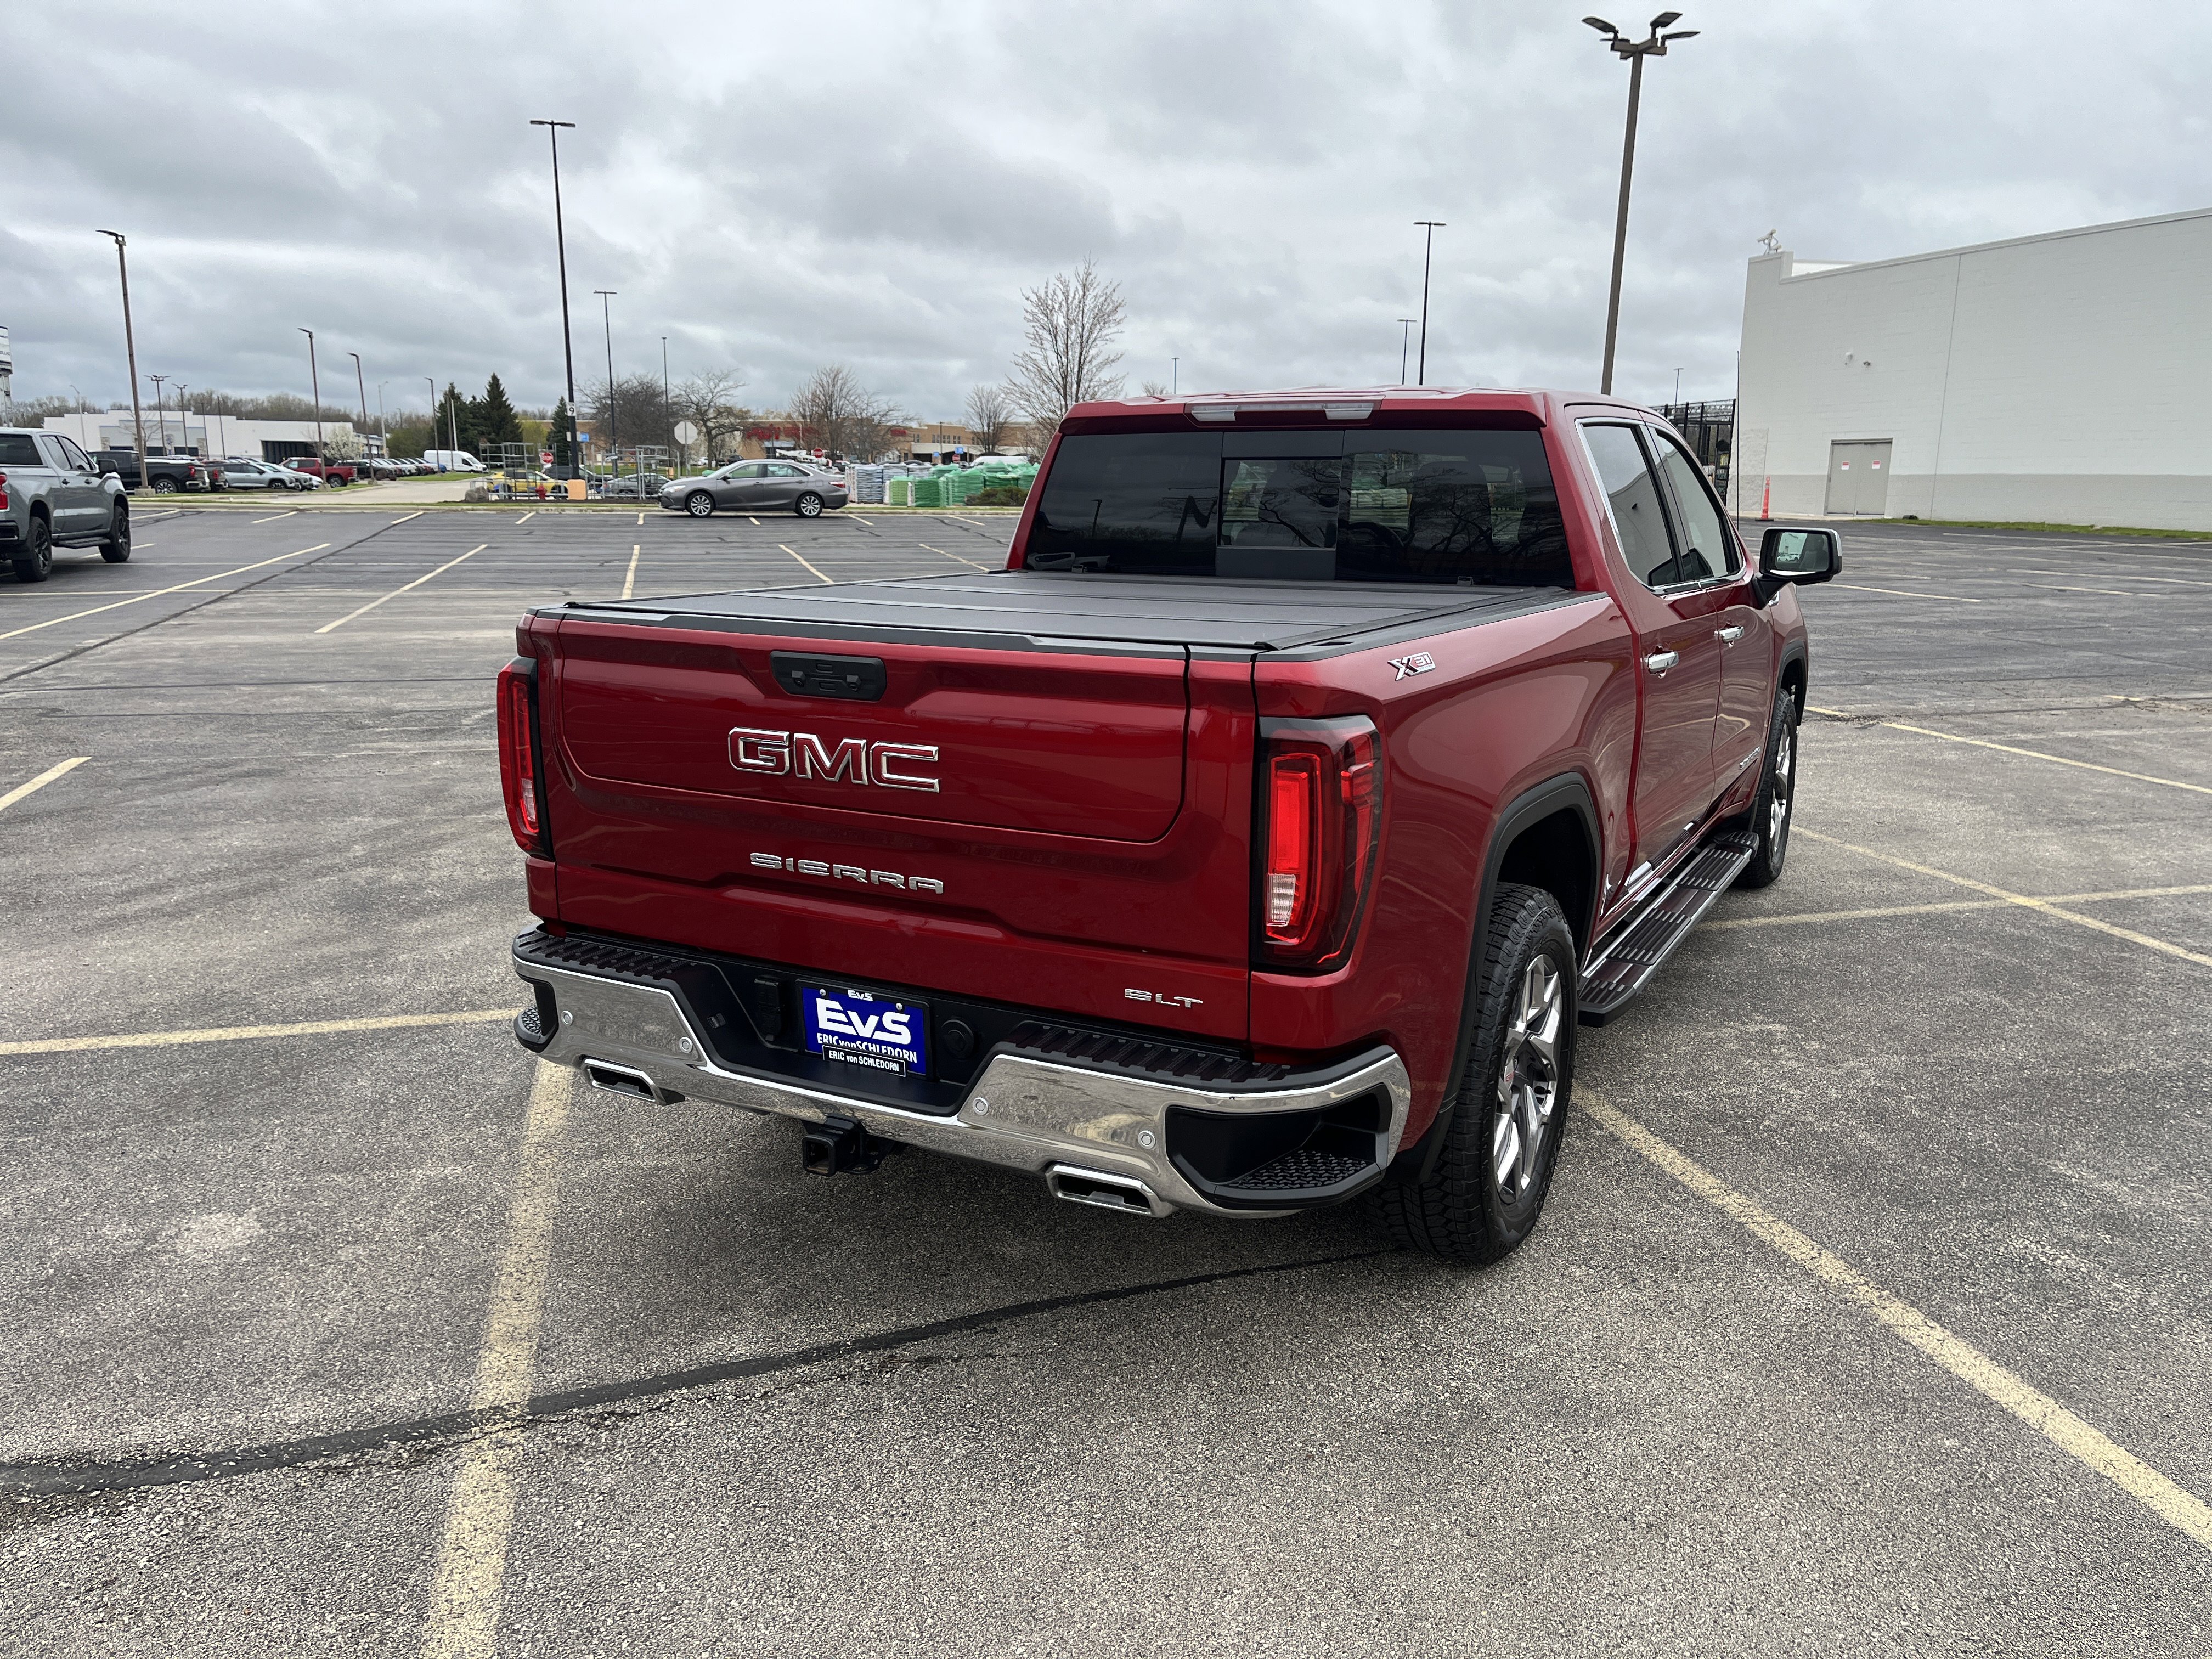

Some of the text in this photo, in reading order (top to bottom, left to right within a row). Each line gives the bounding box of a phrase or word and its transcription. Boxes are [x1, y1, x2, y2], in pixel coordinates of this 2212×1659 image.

[569, 407, 574, 415] 9
[728, 726, 940, 793] GMC
[750, 853, 944, 894] SIERRA
[1125, 989, 1203, 1008] SLT
[829, 1050, 899, 1072] ERIC von SCHLEDORN
